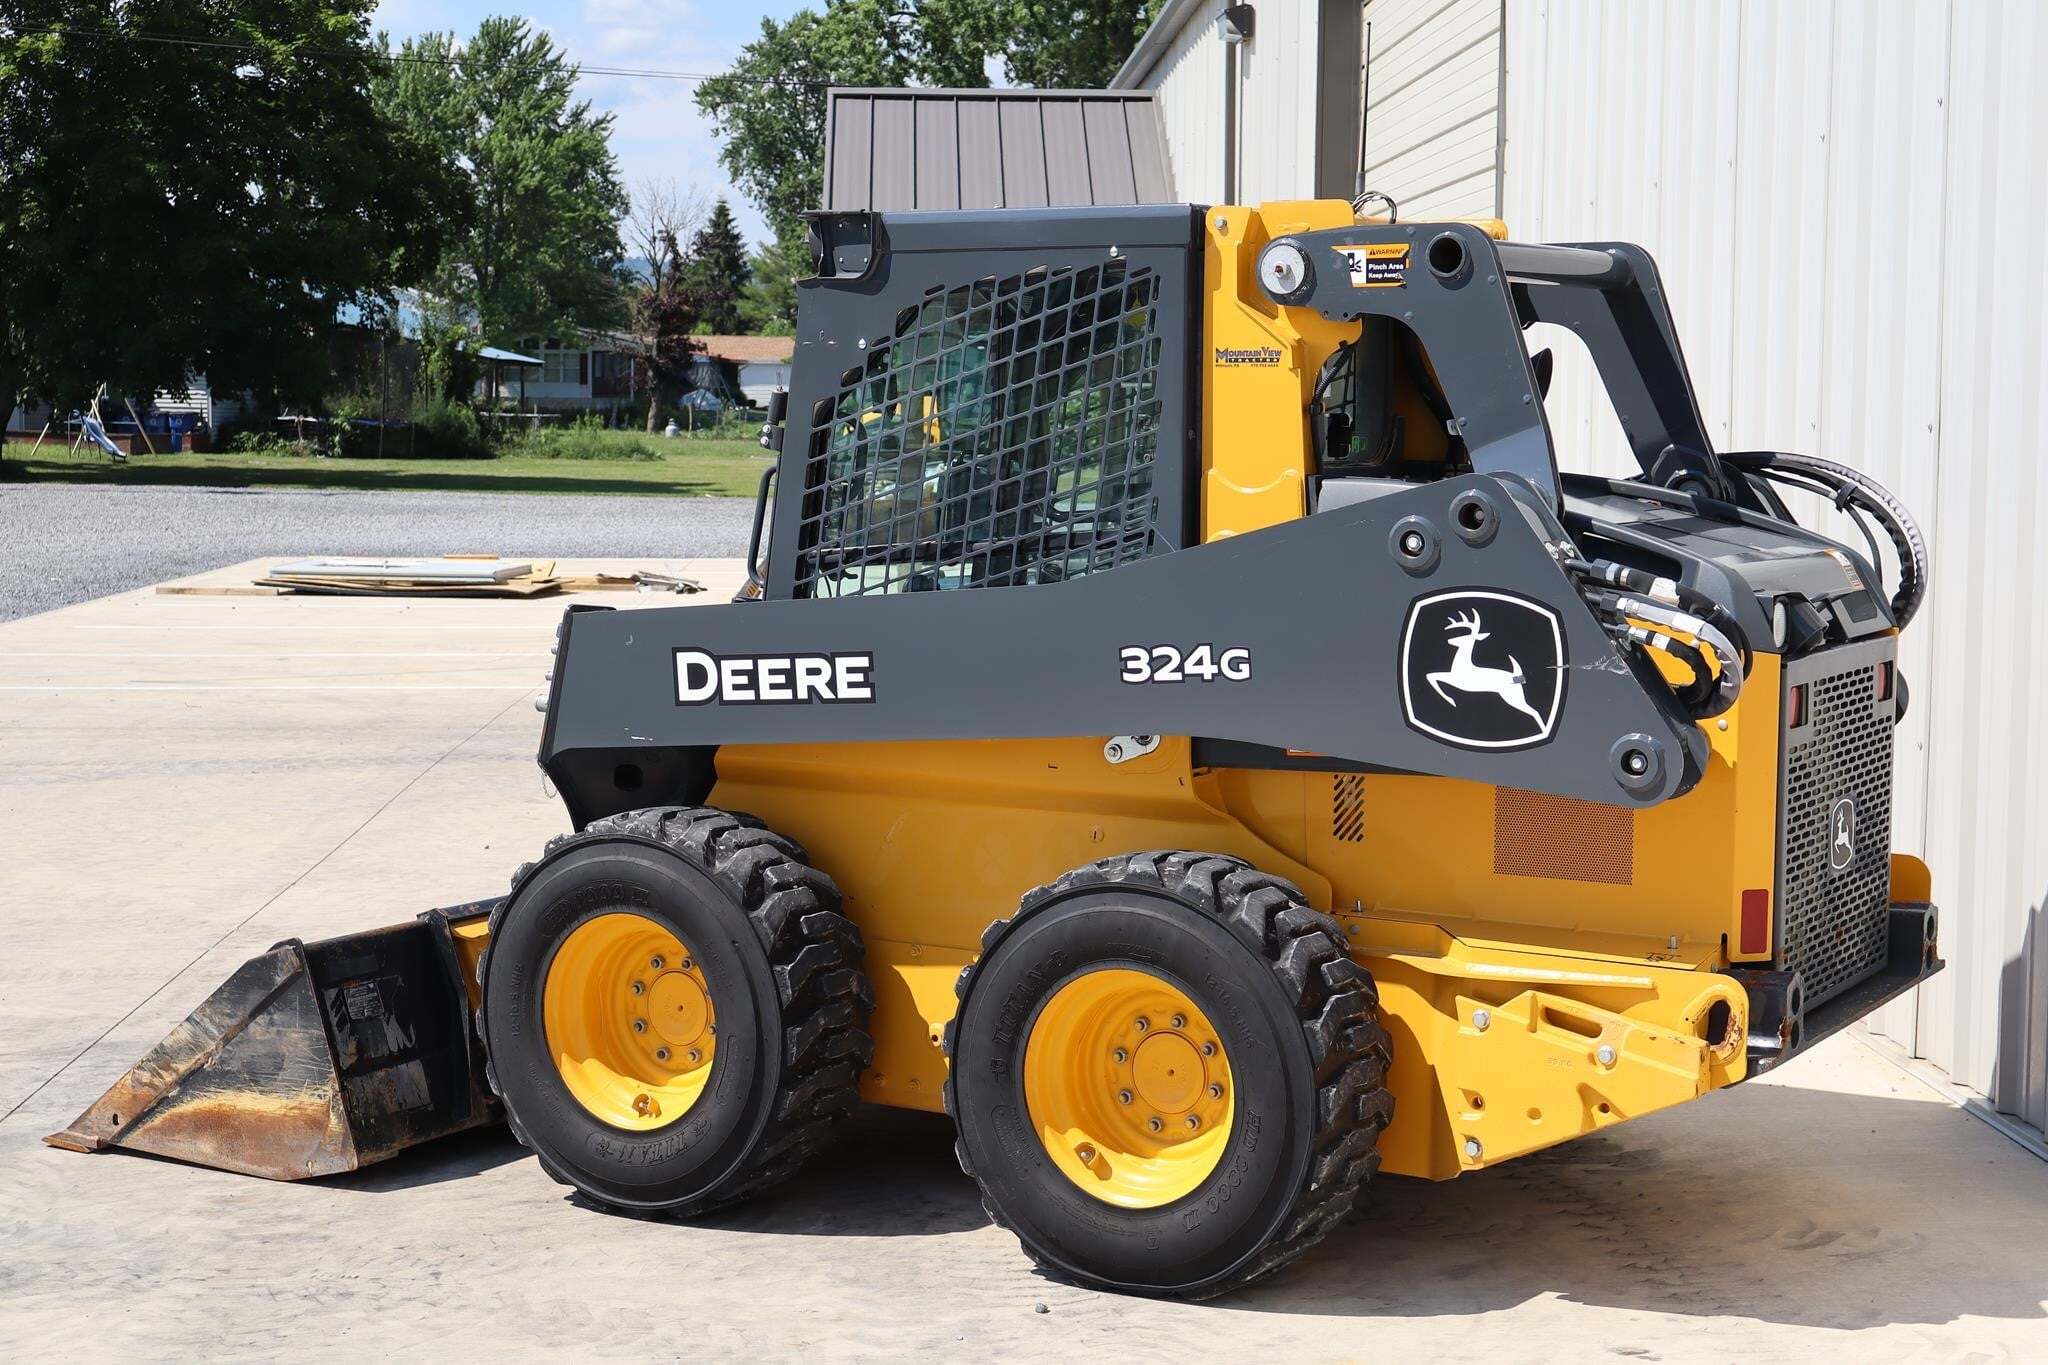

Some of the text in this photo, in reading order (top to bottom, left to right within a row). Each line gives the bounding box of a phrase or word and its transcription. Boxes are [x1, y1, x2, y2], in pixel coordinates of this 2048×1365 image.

[1216, 347, 1281, 363] MOUNTAIN VIEW
[673, 648, 875, 704] DEERE
[1120, 644, 1252, 683] 324G
